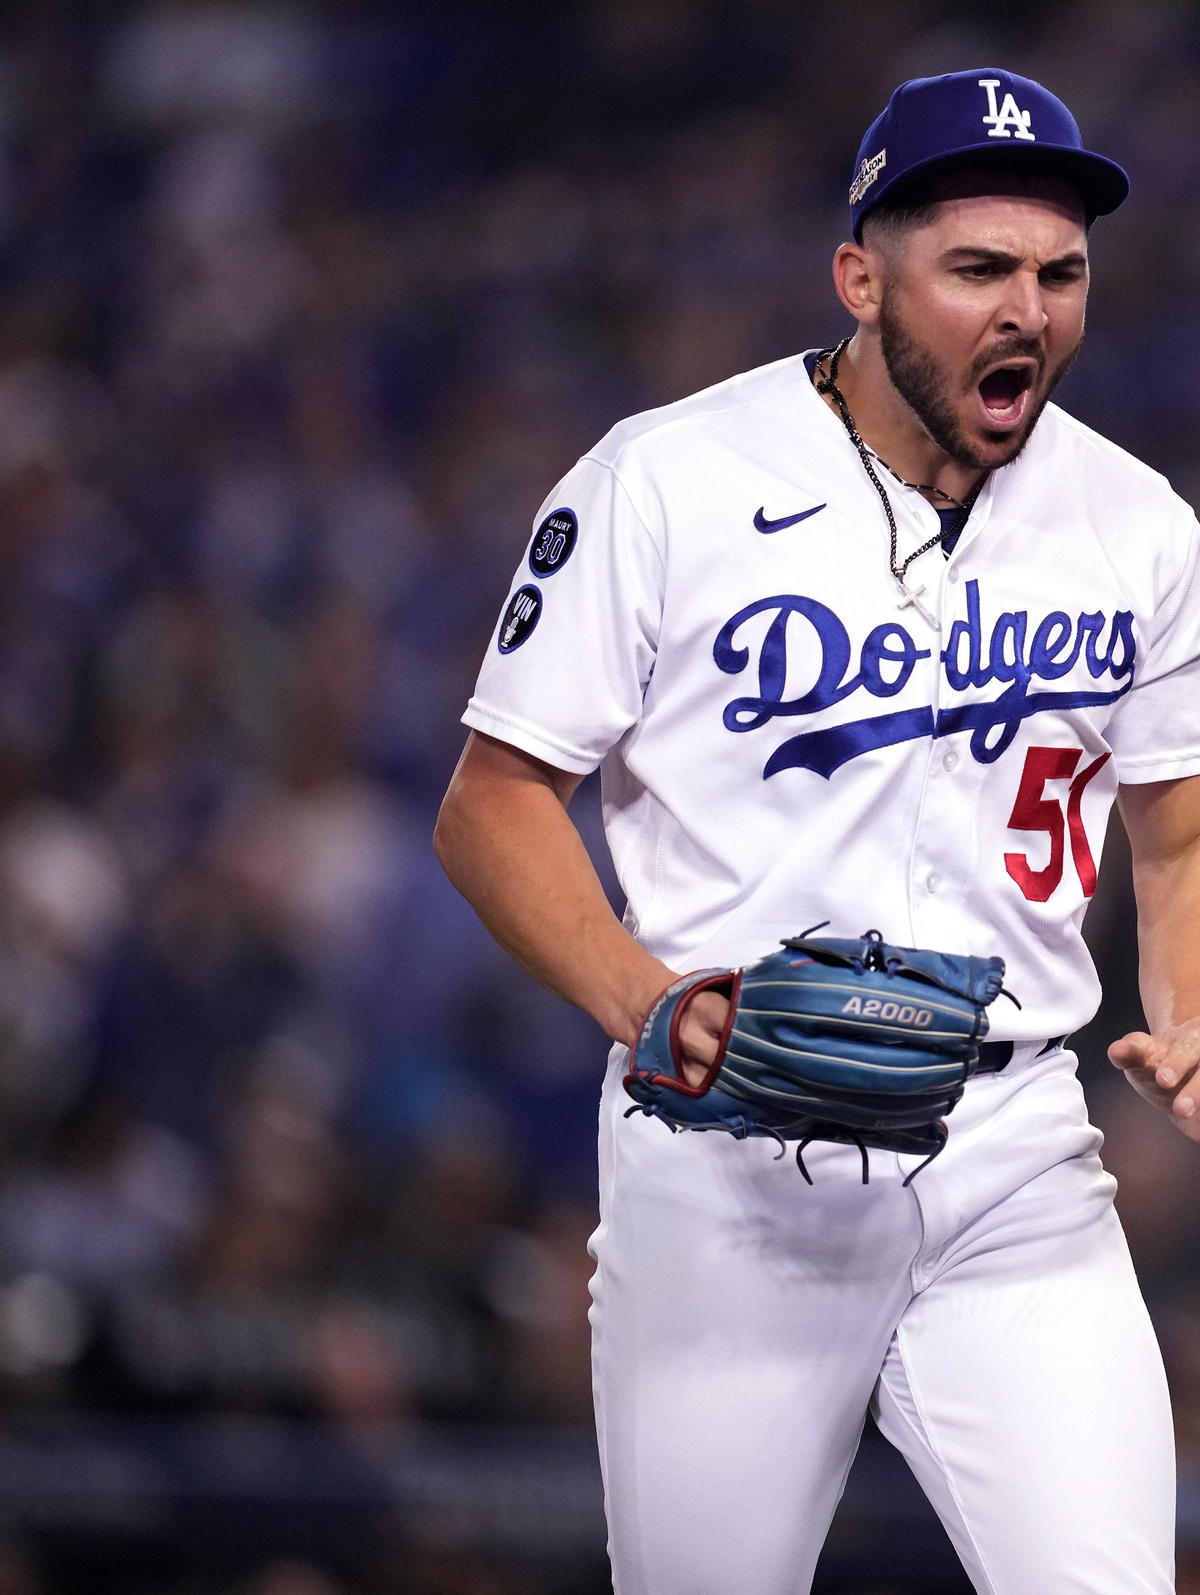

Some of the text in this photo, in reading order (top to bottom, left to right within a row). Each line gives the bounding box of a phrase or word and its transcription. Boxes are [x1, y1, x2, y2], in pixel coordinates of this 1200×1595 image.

[978, 79, 1035, 141] LA
[548, 518, 572, 532] MAURY
[535, 529, 566, 565] 30
[513, 592, 537, 622] VIN
[713, 579, 1137, 764] Dodgers
[842, 996, 933, 1028] A2000
